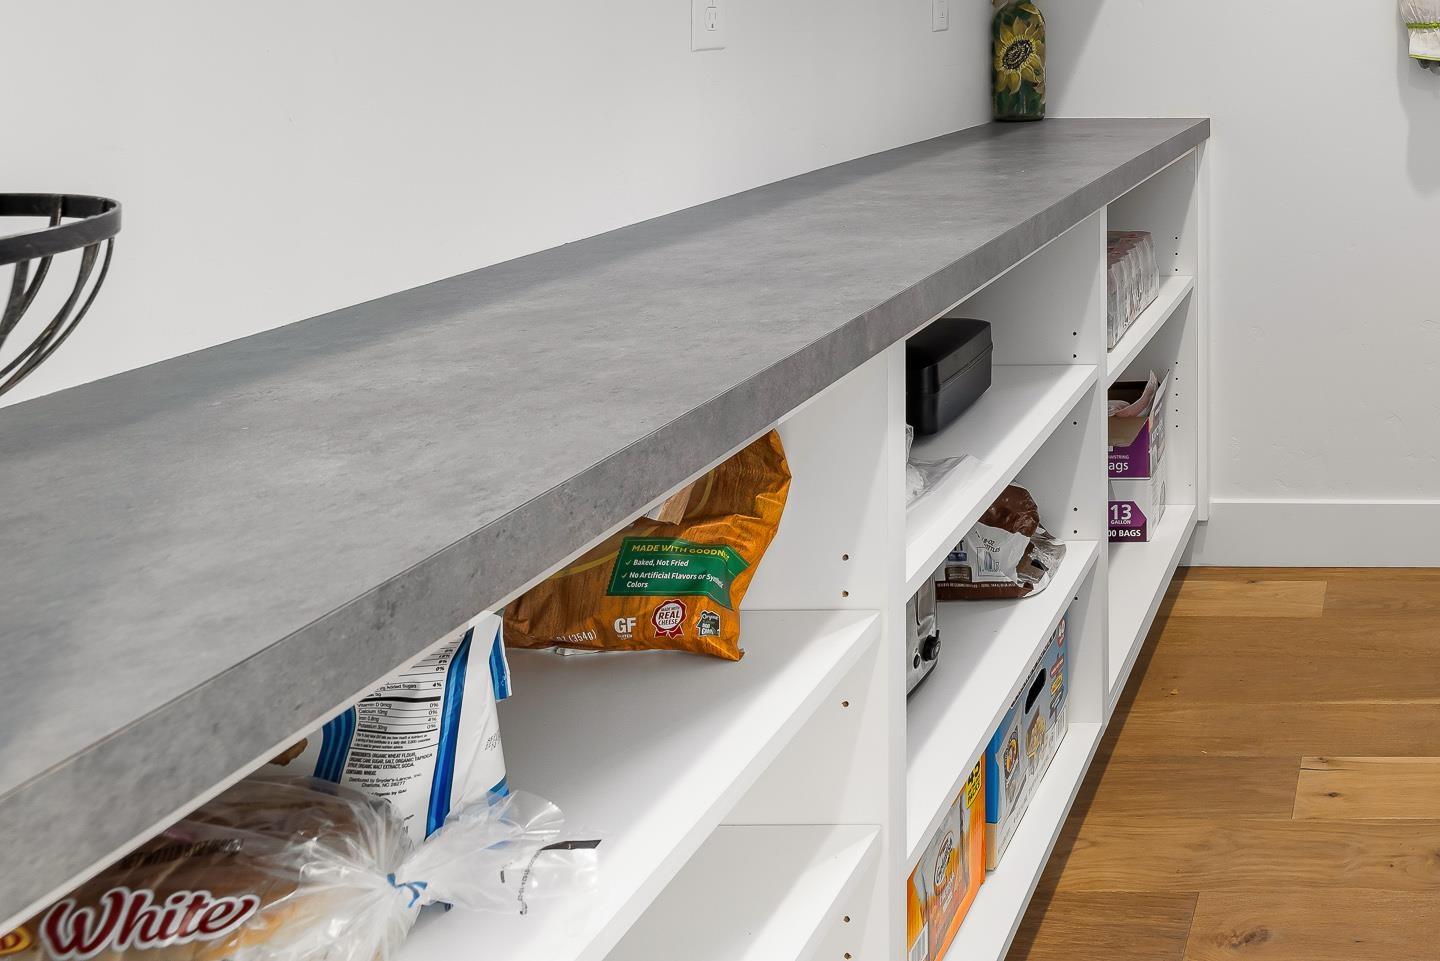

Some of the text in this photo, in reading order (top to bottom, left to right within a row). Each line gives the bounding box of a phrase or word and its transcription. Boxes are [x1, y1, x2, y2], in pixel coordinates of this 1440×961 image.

[1111, 504, 1131, 520] 13
[662, 544, 687, 552] WITH
[671, 572, 696, 580] Flavors
[658, 612, 680, 620] REAL
[614, 618, 637, 633] GF
[42, 888, 259, 958] White
